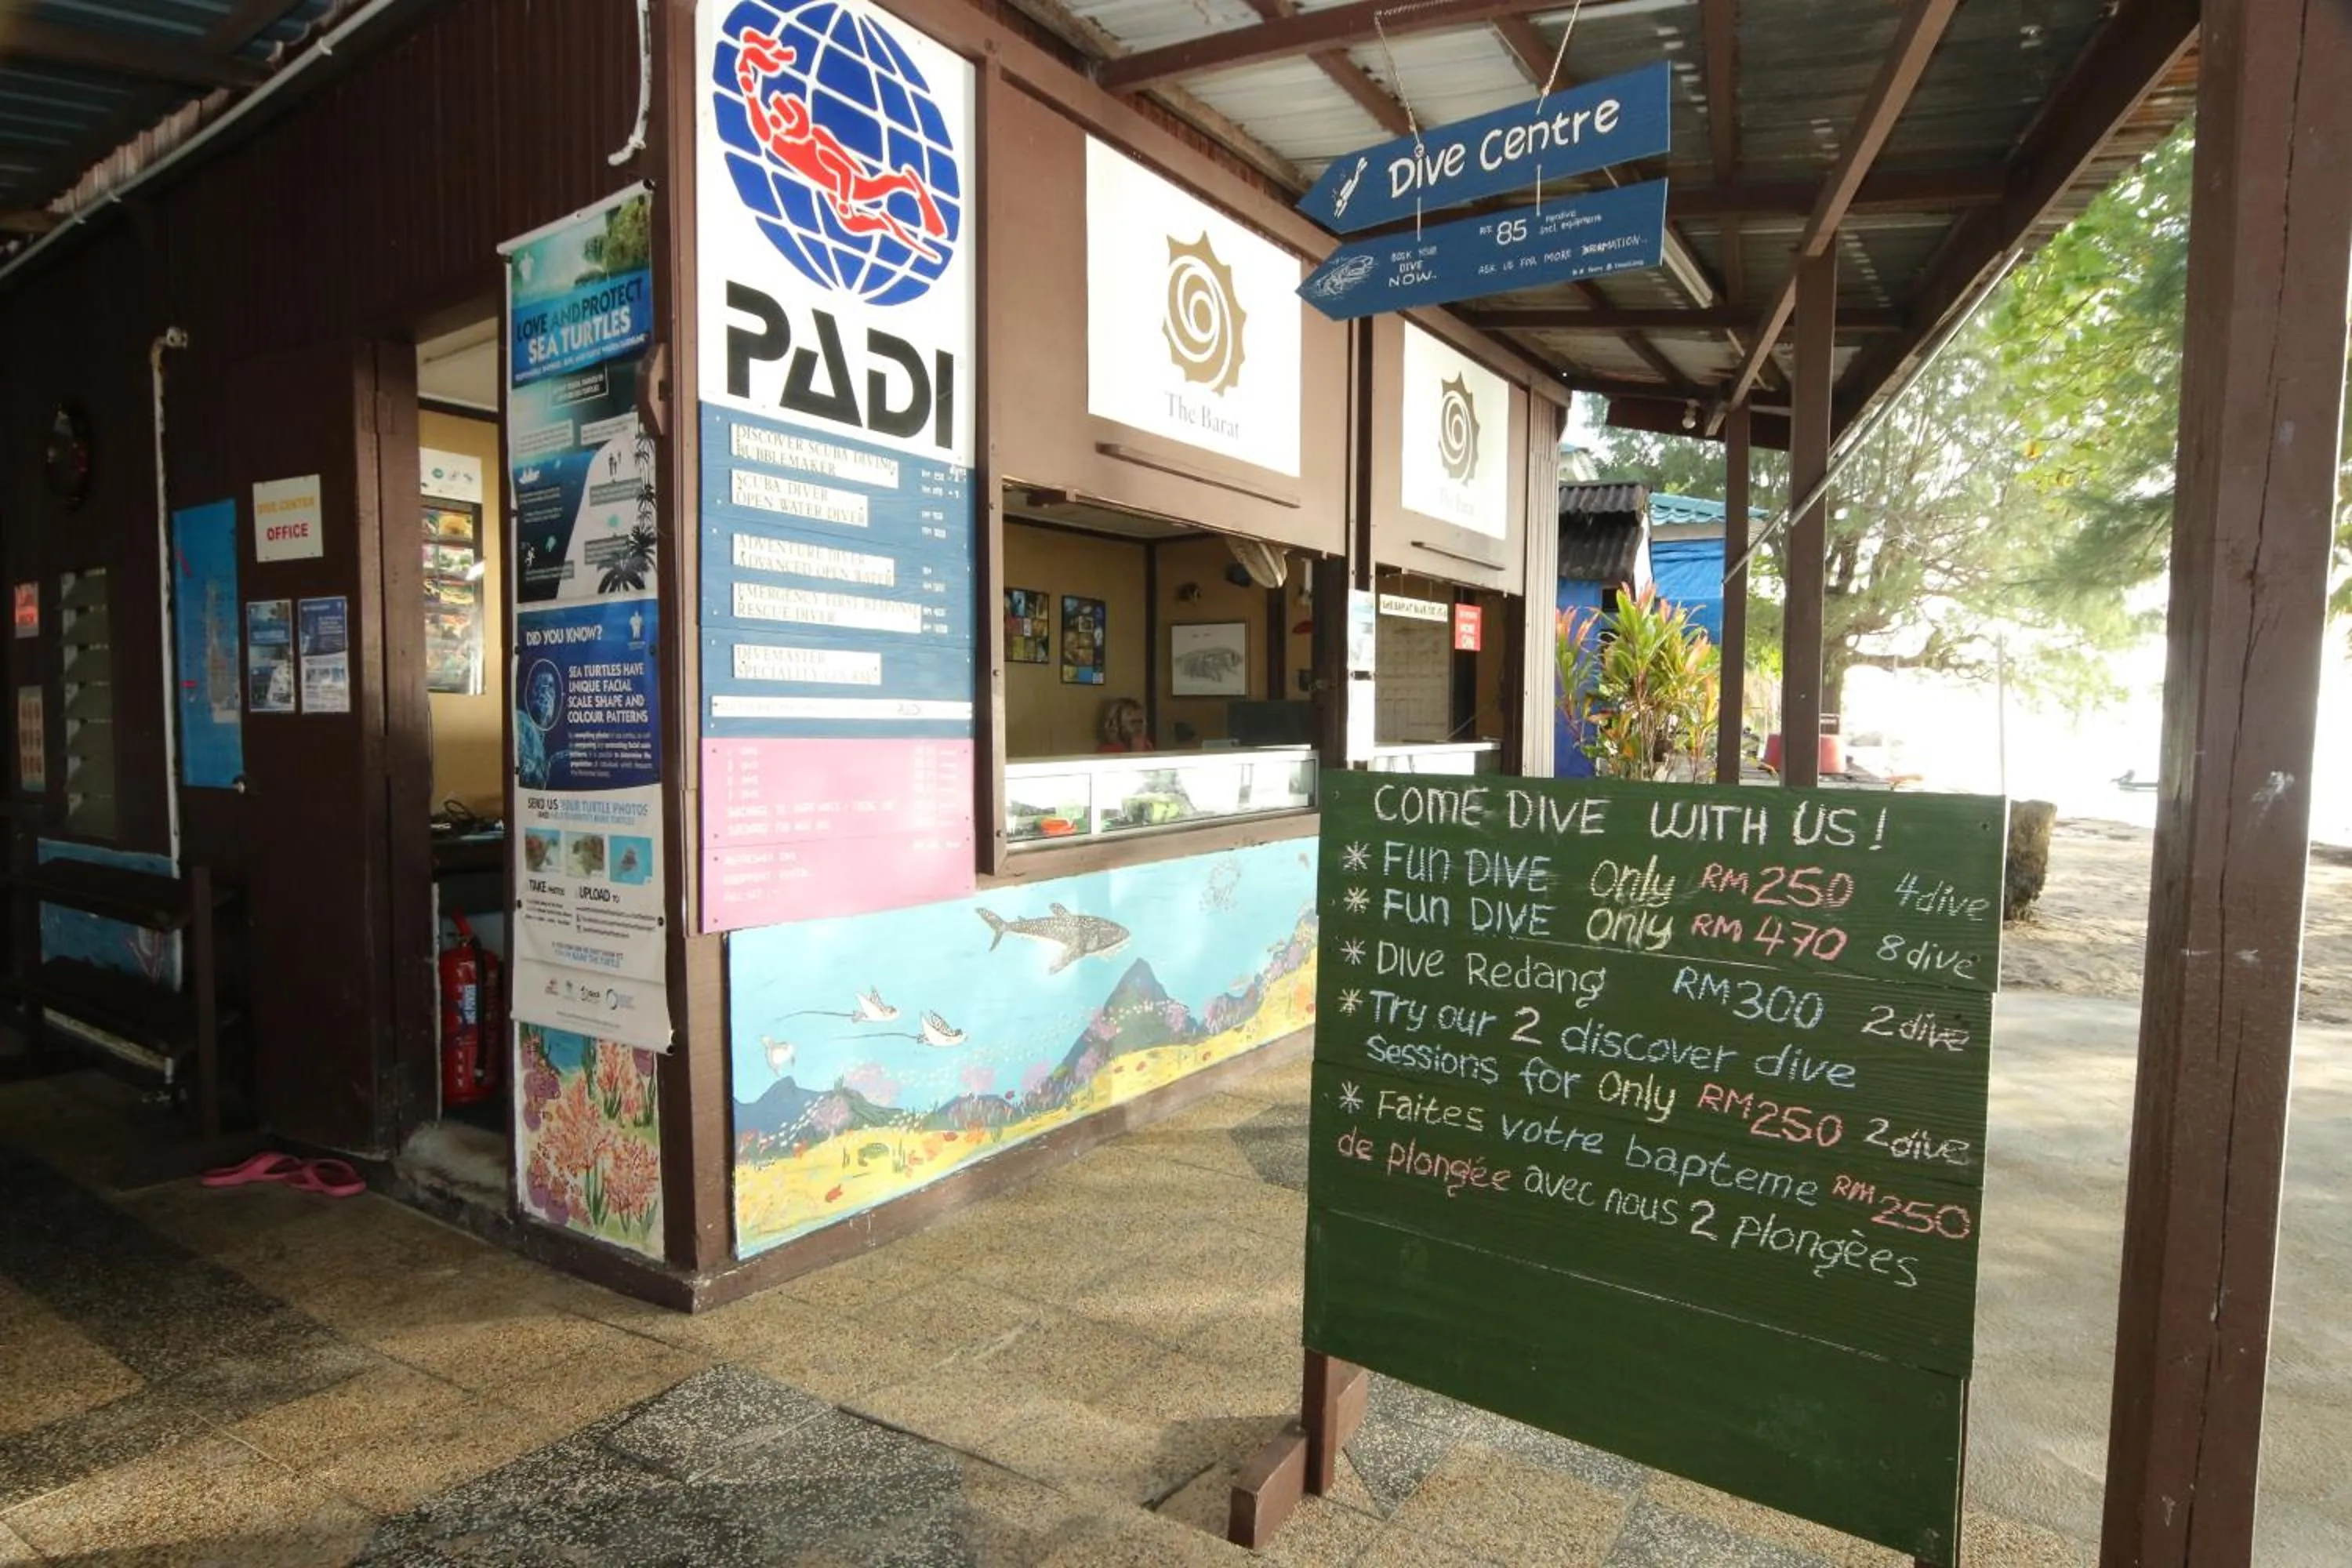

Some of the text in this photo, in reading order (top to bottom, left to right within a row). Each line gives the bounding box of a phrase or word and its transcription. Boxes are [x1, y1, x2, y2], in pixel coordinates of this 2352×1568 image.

[1388, 98, 1621, 199] Dive Centre
[1496, 216, 1528, 245] 85
[1399, 260, 1424, 274] DIVE
[1544, 249, 1572, 263] MORE
[516, 314, 548, 343] LOVE
[582, 277, 643, 317] PROTECT
[528, 332, 559, 365] SEA
[560, 306, 632, 350] TURTLES
[726, 280, 954, 451] PADI
[1164, 390, 1240, 440] The Barat
[736, 473, 829, 501] SCUBA DIVER
[736, 491, 773, 508] OPEN
[267, 522, 309, 541] OFFICE
[526, 625, 603, 646] DID YOU KNOW?
[568, 662, 644, 677] SEA TURTLES HAVE
[568, 678, 632, 693] UNIQUE FACIAL
[568, 694, 645, 709] SCALE SHAPE AND
[568, 710, 649, 724] COLOUR PATTERNS
[546, 798, 559, 810] US
[612, 801, 649, 816] PHOTOS
[1374, 784, 1489, 827] COME
[1506, 789, 1612, 835] DIVE
[1650, 800, 1769, 846] WITH
[528, 879, 546, 893] TAKE
[1383, 840, 1451, 884] Fun
[1465, 848, 1552, 892] DIVE
[1591, 854, 1676, 906] Only
[579, 886, 611, 902] UPLOAD
[1383, 888, 1450, 927] Fun
[1471, 896, 1557, 936] DIVE
[1586, 908, 1673, 951] Only
[1377, 941, 1446, 978] Dive
[1466, 952, 1606, 1010] Redang
[1369, 989, 1856, 1088] Try our 2 discover dive
[1367, 1033, 1499, 1085] Sessions
[1519, 1056, 1581, 1098] for
[1599, 1070, 1676, 1123] Only
[1377, 1090, 1486, 1132] Faites
[1501, 1113, 1604, 1155] votre
[1625, 1134, 1818, 1206] bapteme
[1338, 1126, 1374, 1162] de
[1524, 1164, 1595, 1207] avec
[1604, 1187, 1679, 1225] nous
[1690, 1200, 1719, 1241] 2
